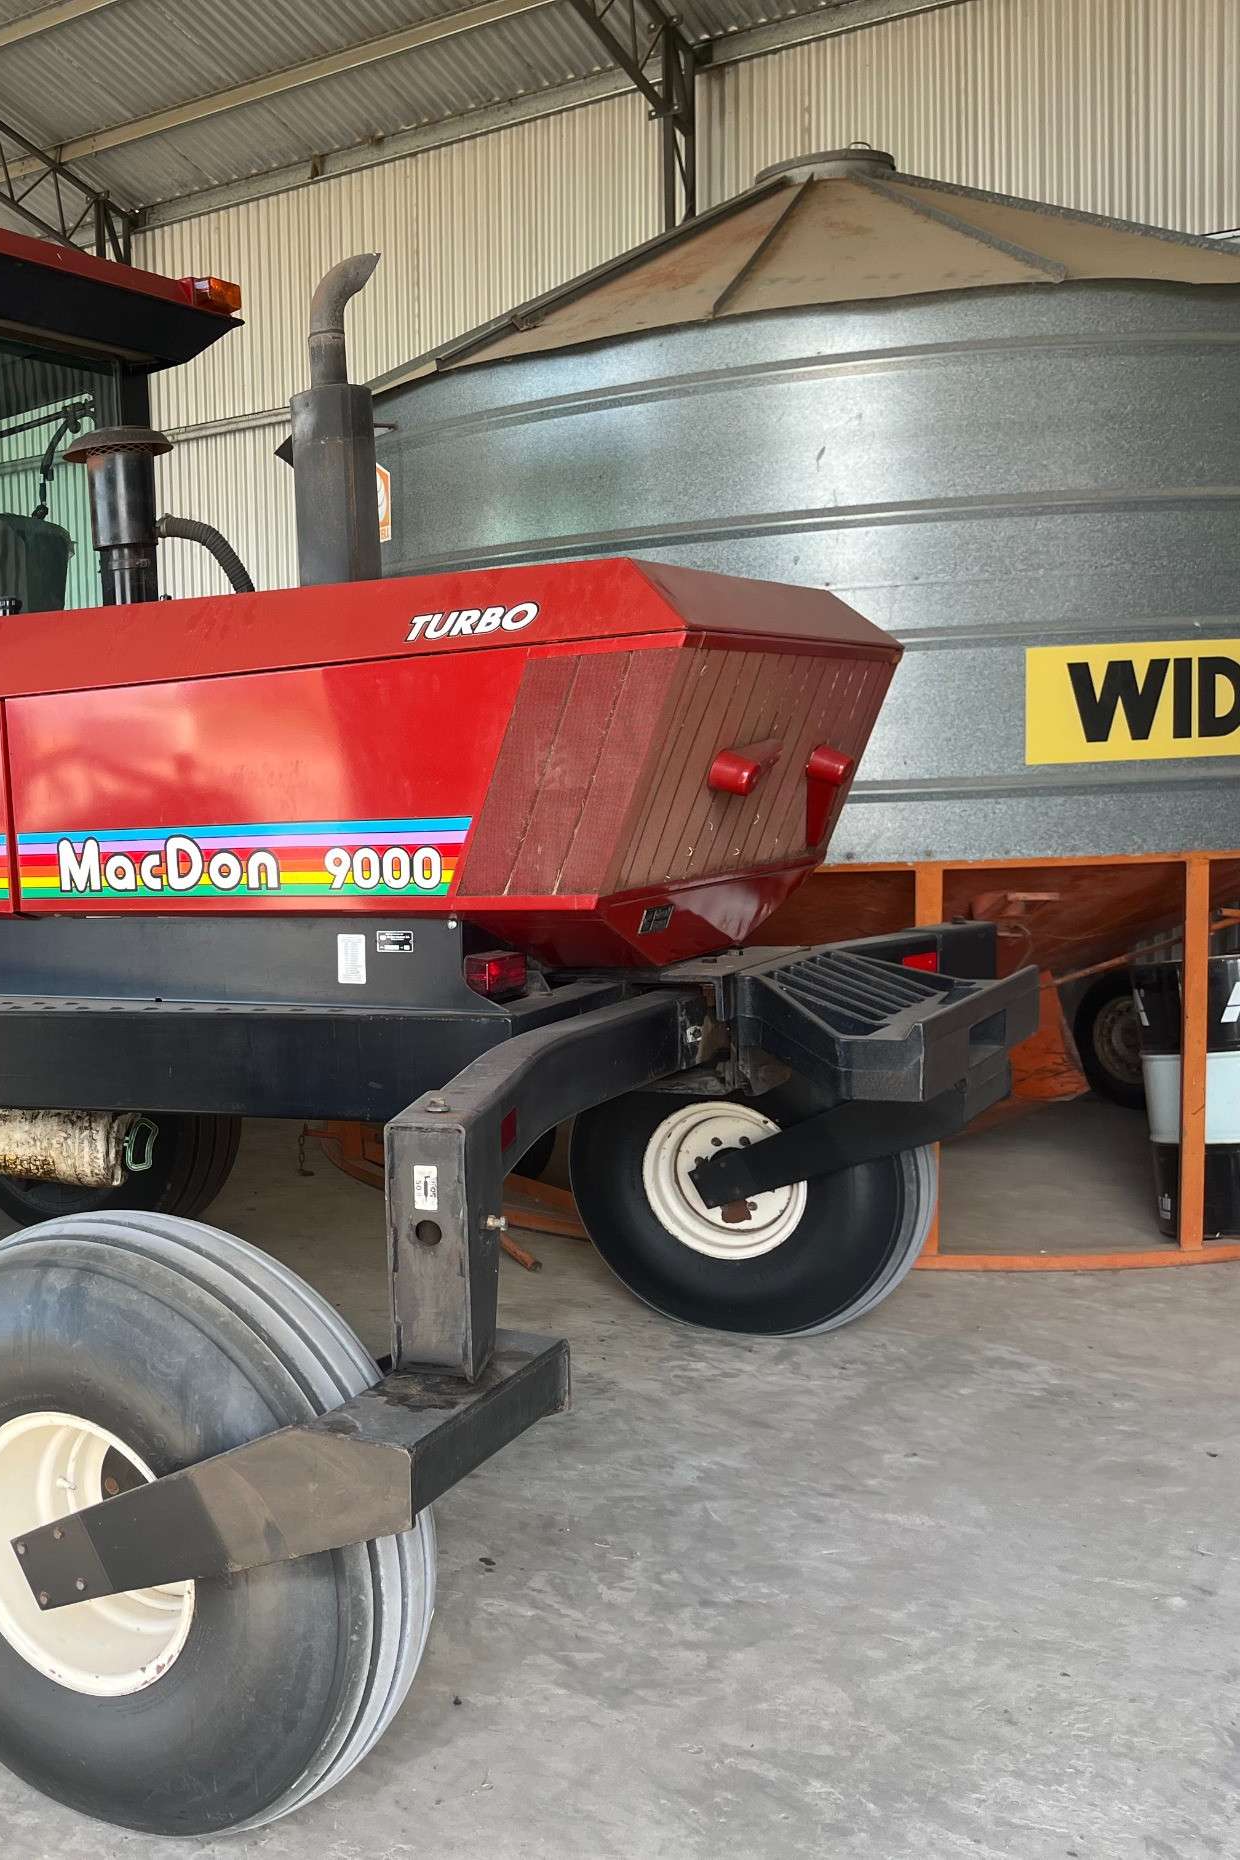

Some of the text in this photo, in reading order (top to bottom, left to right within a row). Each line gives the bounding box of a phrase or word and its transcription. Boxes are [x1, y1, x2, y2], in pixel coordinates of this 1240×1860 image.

[405, 602, 540, 642] TURBO
[1067, 656, 1240, 743] WID
[57, 834, 442, 893] MacDon 9000
